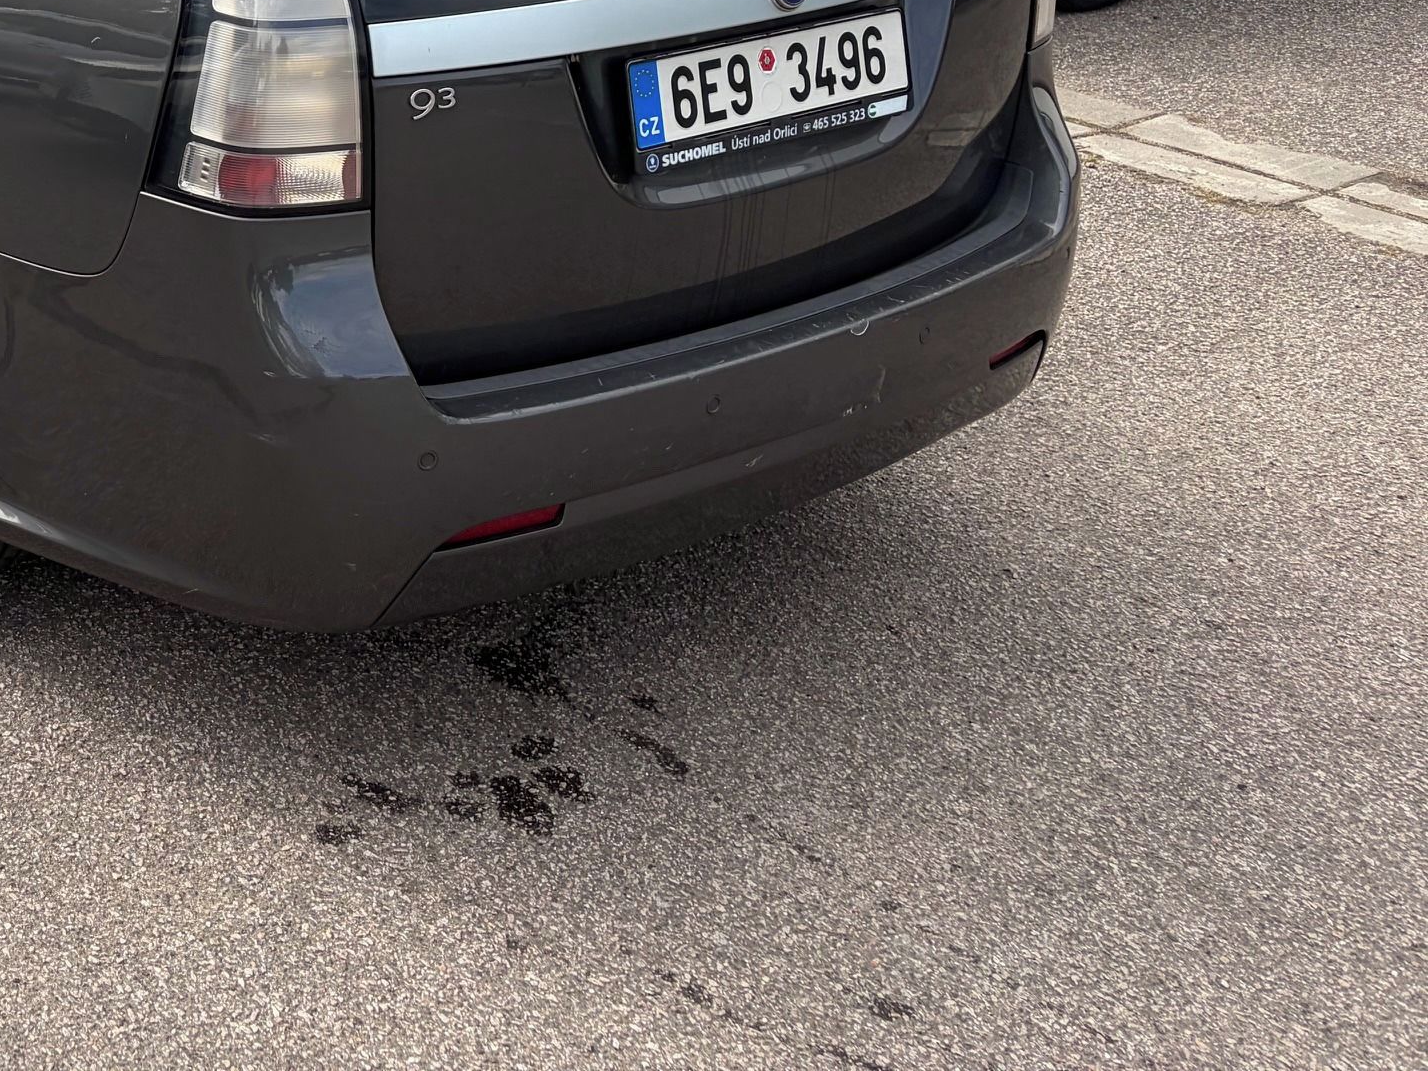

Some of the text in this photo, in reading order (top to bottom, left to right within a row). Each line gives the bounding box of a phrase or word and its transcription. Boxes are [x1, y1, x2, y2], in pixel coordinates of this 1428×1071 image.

[670, 25, 887, 129] 6E9 3496
[639, 116, 661, 138] CZ
[661, 109, 867, 168] SUCHOMEL Ústí nad Orlicí 465 525 323
